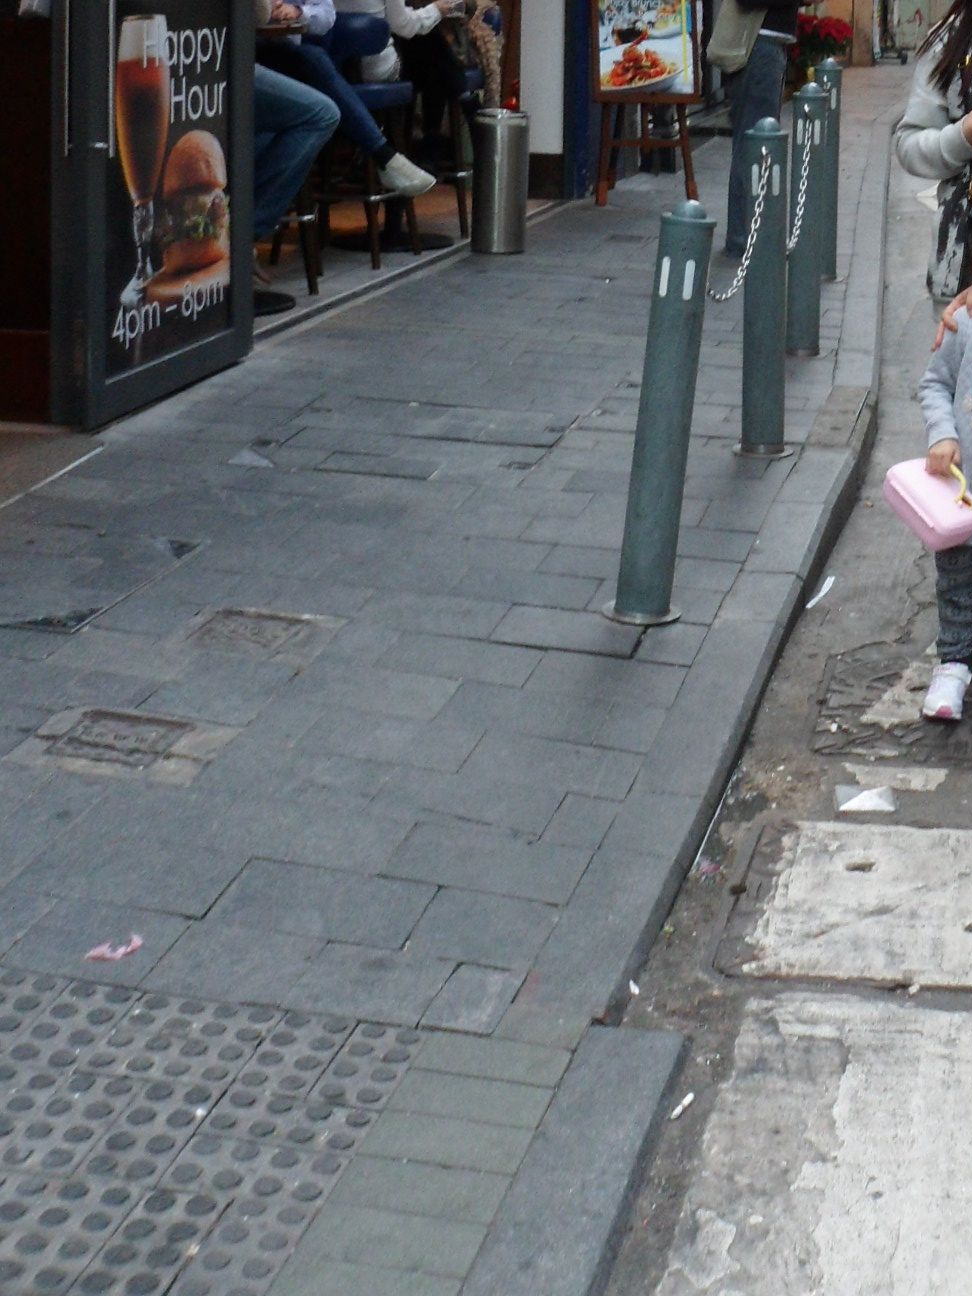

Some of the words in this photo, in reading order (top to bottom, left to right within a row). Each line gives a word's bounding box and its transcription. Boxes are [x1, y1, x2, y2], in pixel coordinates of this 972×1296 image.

[143, 23, 227, 77] Happy
[170, 76, 227, 125] Hour
[112, 301, 161, 350] 4pm
[181, 280, 225, 322] 8pm
